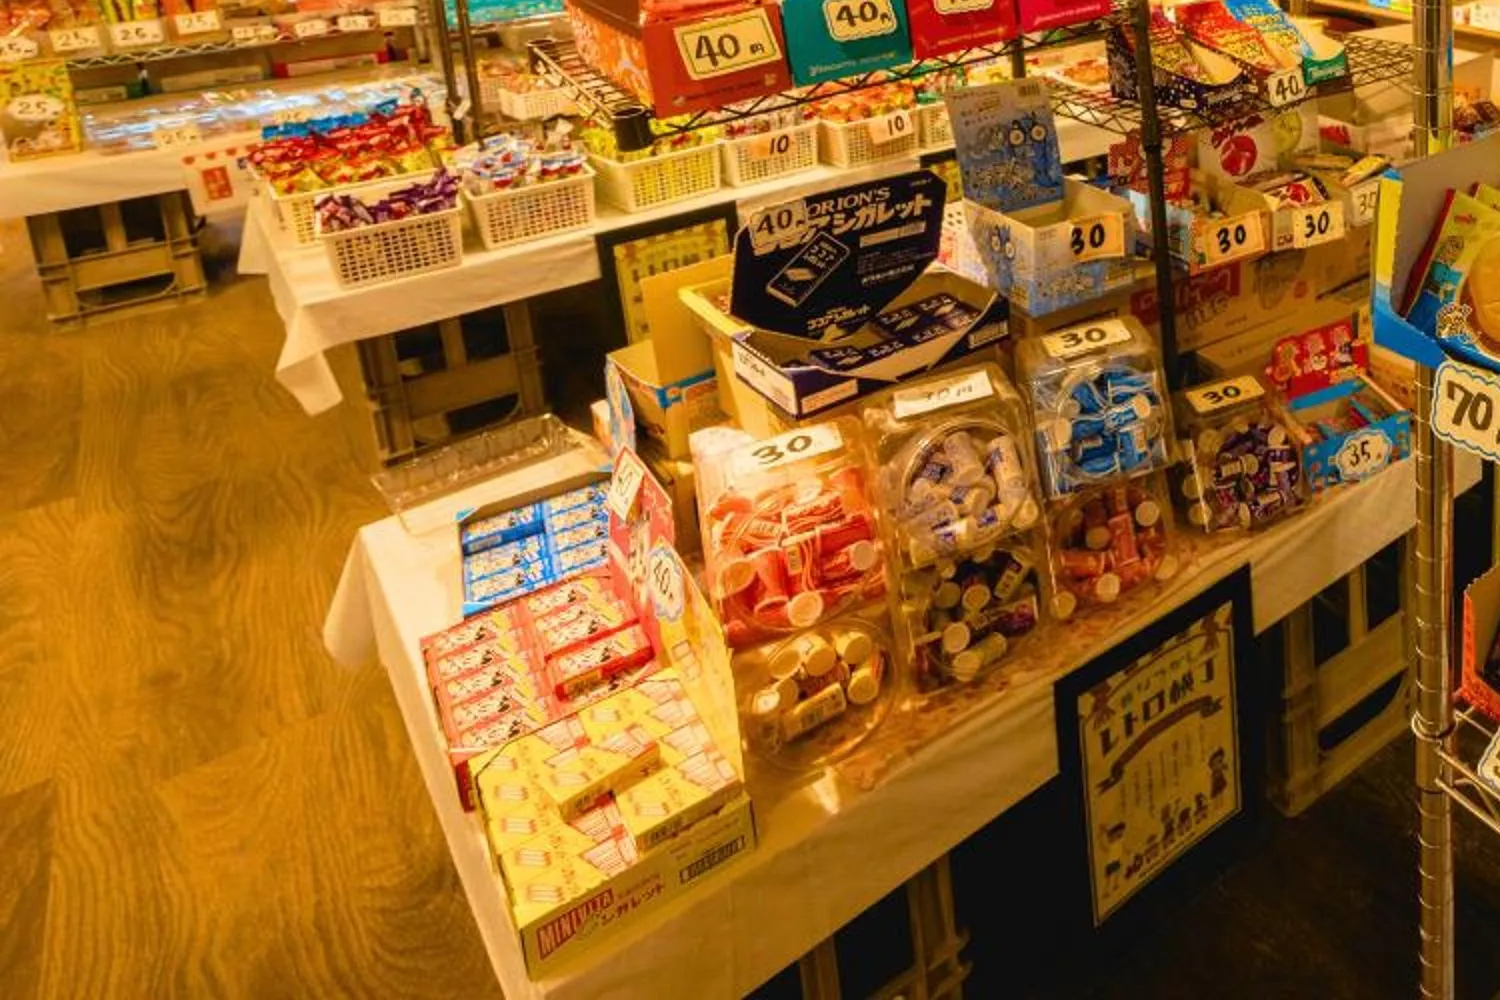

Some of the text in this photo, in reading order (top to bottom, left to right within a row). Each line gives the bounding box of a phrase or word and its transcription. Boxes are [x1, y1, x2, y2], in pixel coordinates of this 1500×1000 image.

[836, 0, 891, 30] 40円
[694, 30, 766, 68] 40円
[886, 114, 905, 133] 10
[768, 133, 790, 154] 10
[807, 186, 891, 217] ORION'S
[1070, 222, 1106, 254] 30
[1216, 224, 1247, 254] 30
[1304, 210, 1330, 238] 30
[1062, 325, 1107, 347] 30
[1202, 383, 1241, 405] 30
[750, 434, 813, 465] 30
